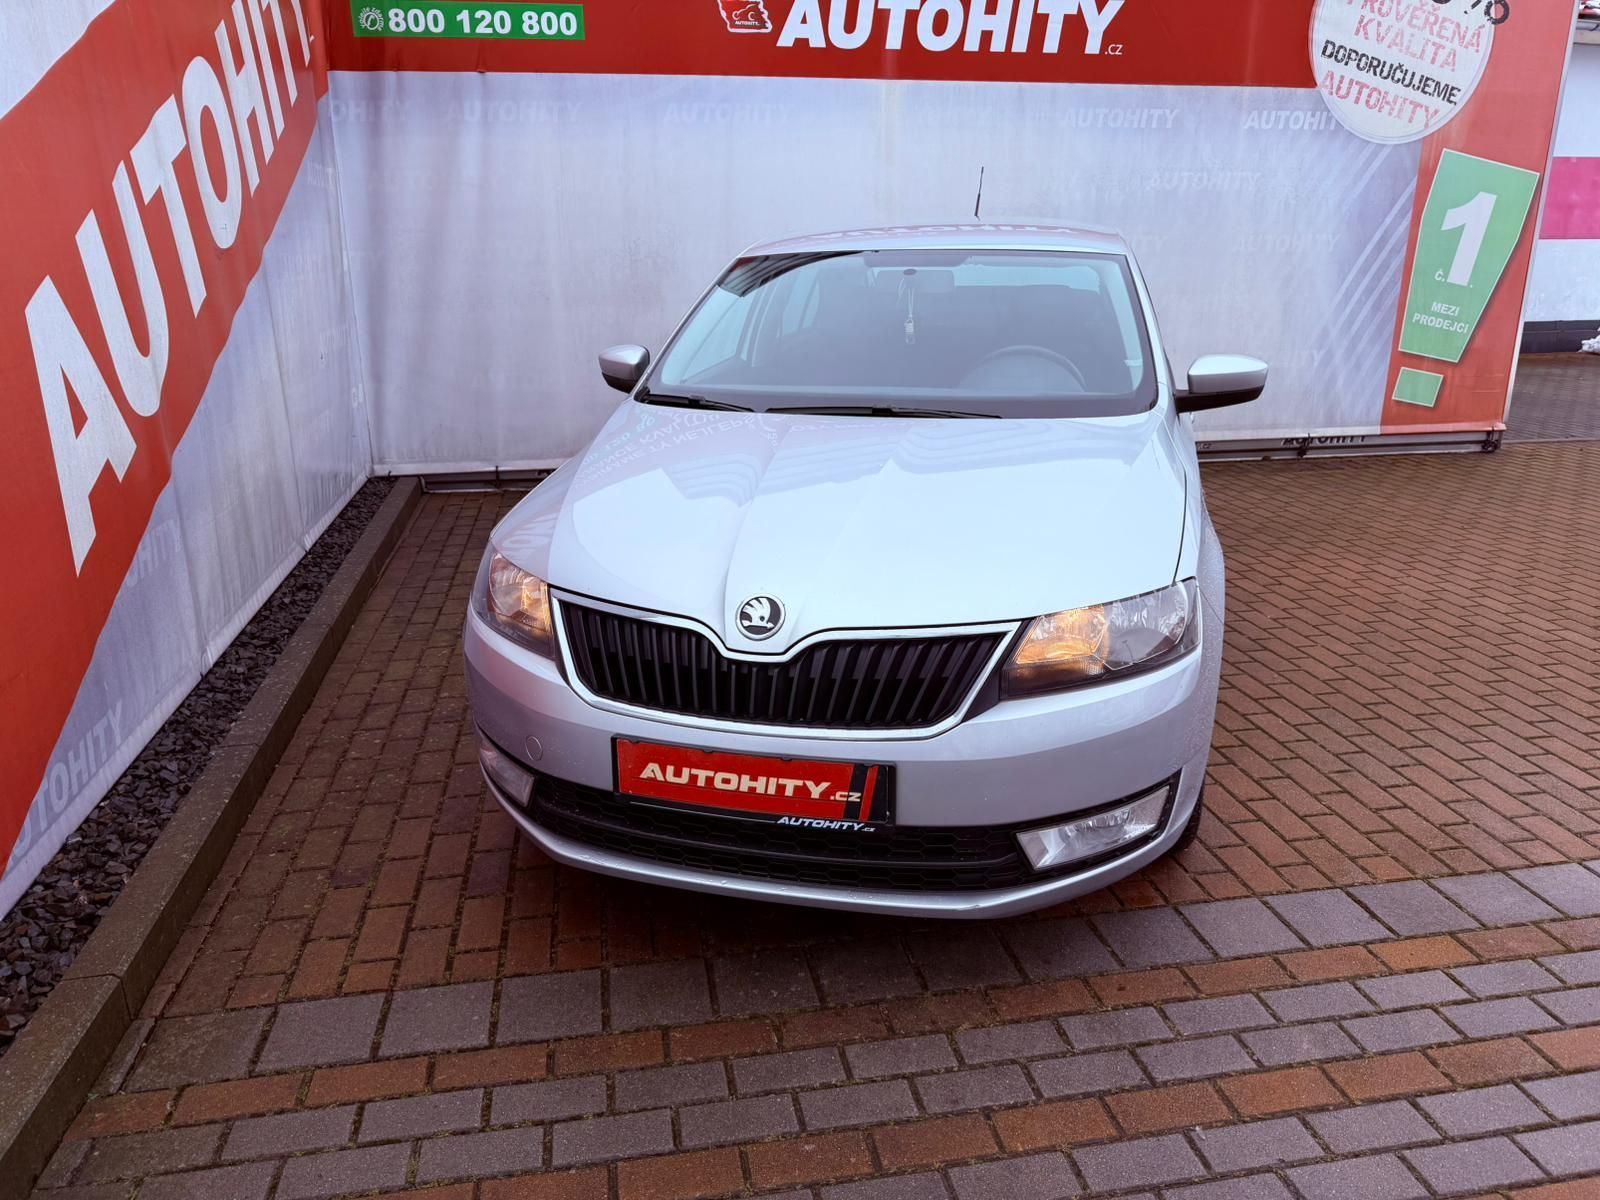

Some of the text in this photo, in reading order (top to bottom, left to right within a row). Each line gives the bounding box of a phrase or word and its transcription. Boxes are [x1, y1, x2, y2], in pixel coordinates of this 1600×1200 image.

[388, 8, 577, 36] 800 120 800
[1348, 0, 1485, 53] ROVĚŘENÁ
[1354, 14, 1457, 72] KVALITA
[1320, 38, 1462, 106] DOPORUČUJEME
[1063, 108, 1180, 129] AUTOHITY
[1322, 70, 1440, 129] AUTOHITY
[1412, 313, 1469, 334] PRODEJCI
[1431, 301, 1460, 317] MEZI
